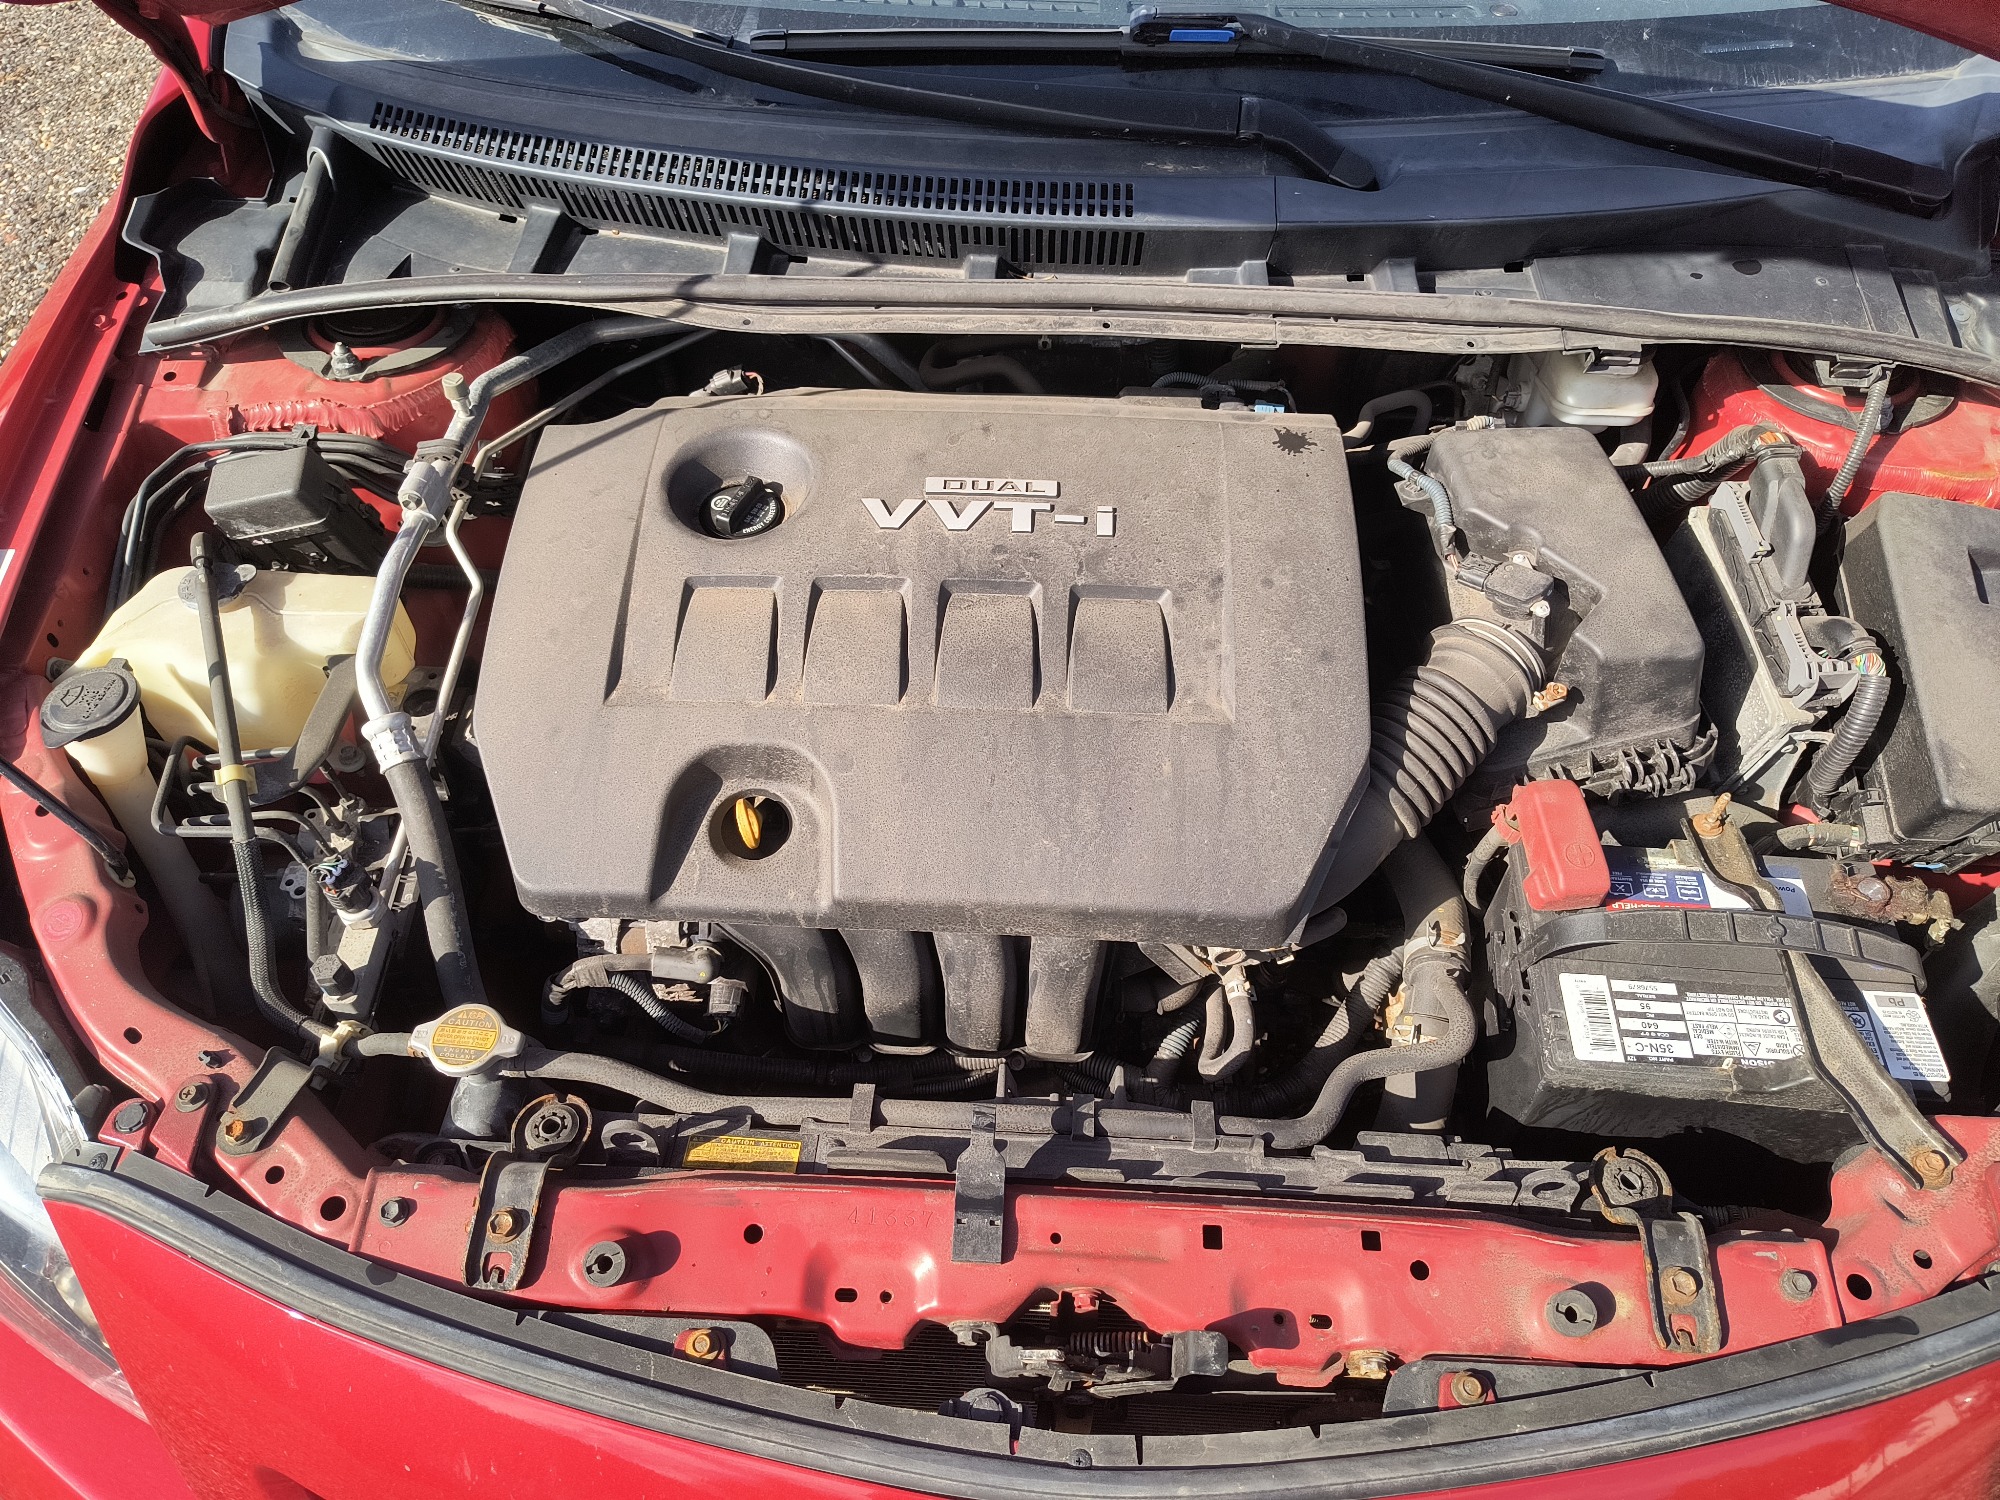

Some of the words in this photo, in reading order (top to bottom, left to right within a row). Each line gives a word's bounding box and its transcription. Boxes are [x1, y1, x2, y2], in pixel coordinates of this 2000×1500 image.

[943, 479, 1046, 493] DUAL
[860, 498, 1118, 538] VVT-i
[1888, 997, 1905, 1007] Pb
[448, 1018, 493, 1028] CAUTION
[1641, 1021, 1658, 1029] 640
[443, 1047, 476, 1055] ENGINE
[1635, 1042, 1674, 1054] 35N-C
[720, 1138, 755, 1146] CAUTION
[760, 1141, 798, 1149] ATTENTION
